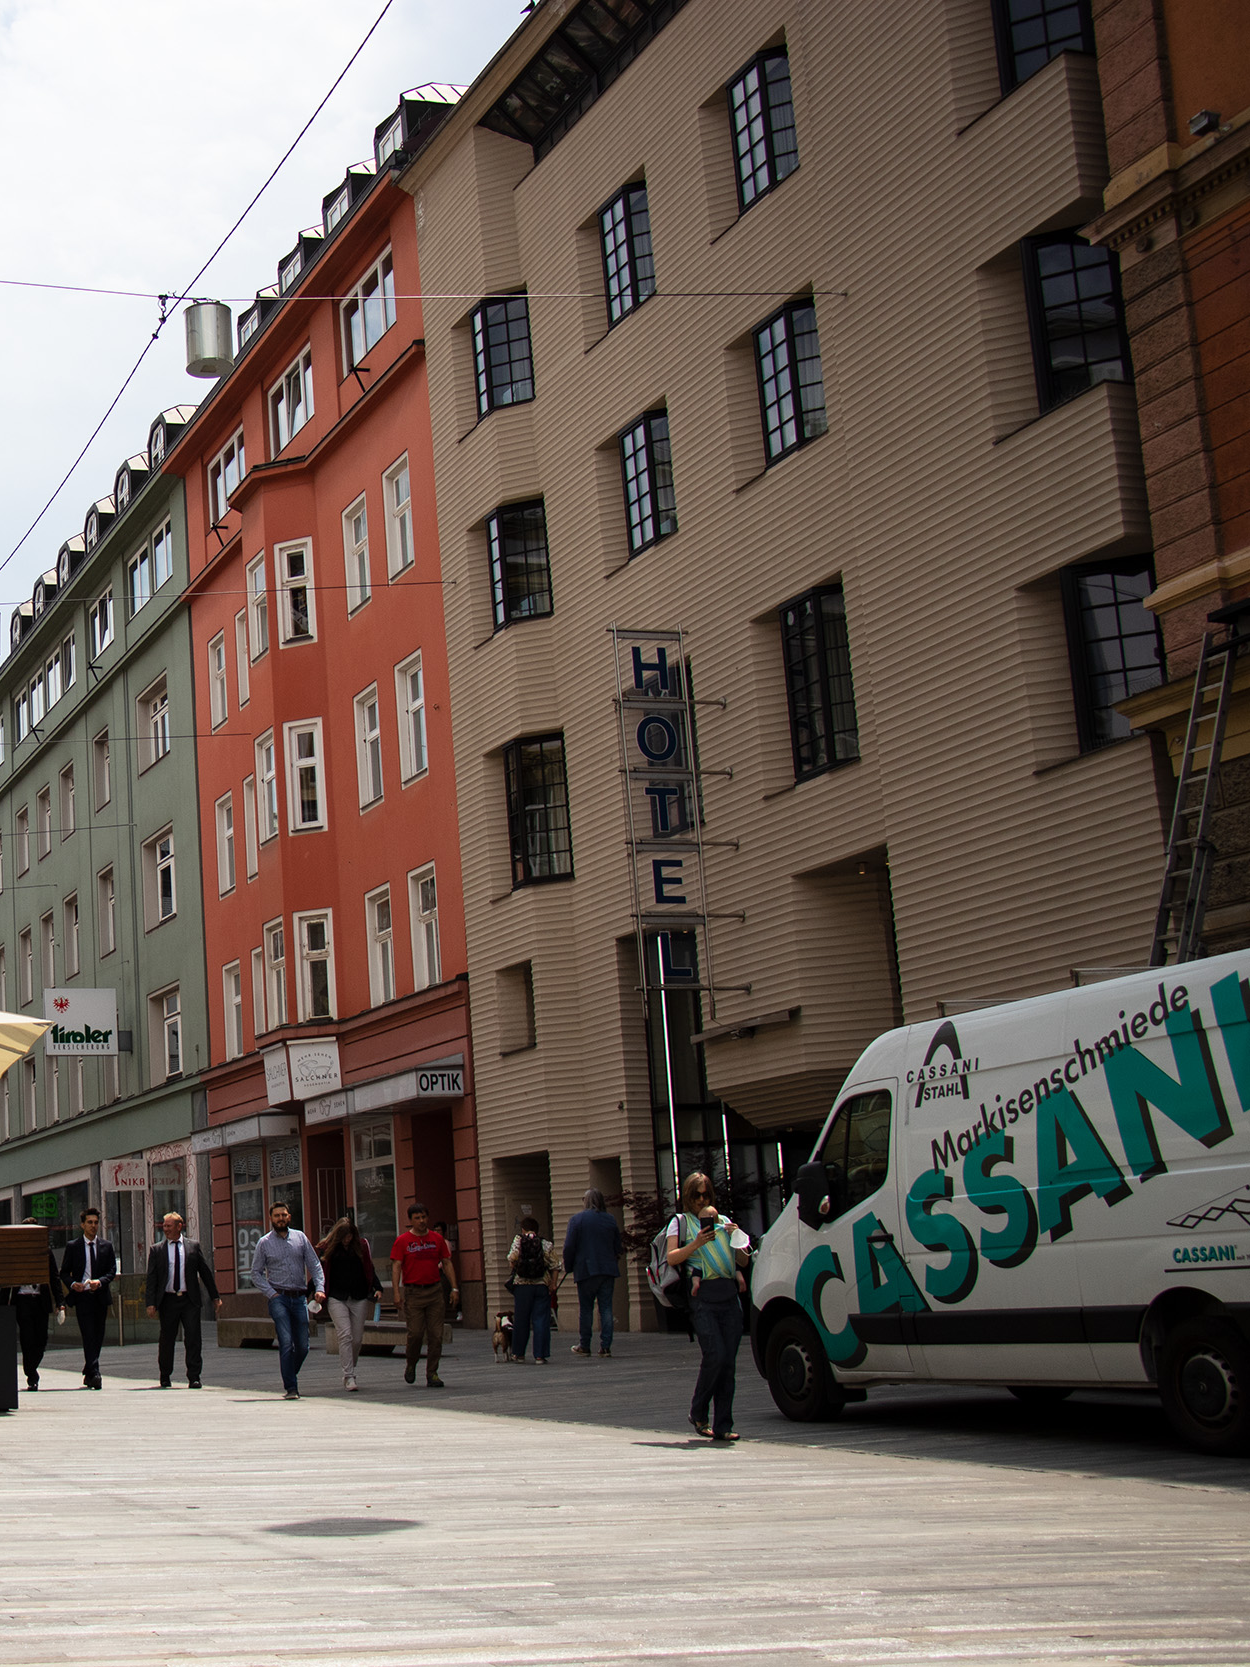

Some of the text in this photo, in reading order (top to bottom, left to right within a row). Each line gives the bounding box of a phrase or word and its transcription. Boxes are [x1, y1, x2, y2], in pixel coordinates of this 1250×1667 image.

[631, 645, 693, 979] HOTEL
[51, 1023, 112, 1043] tiroler
[295, 1072, 338, 1082] SALCHNER
[906, 1057, 979, 1083] CASSANI
[930, 981, 1189, 1175] Markisenschmiede
[418, 1073, 461, 1092] OPTIK
[923, 1082, 962, 1100] STAHL
[795, 970, 1250, 1369] CASSANI
[1173, 1245, 1235, 1263] CASSANI
